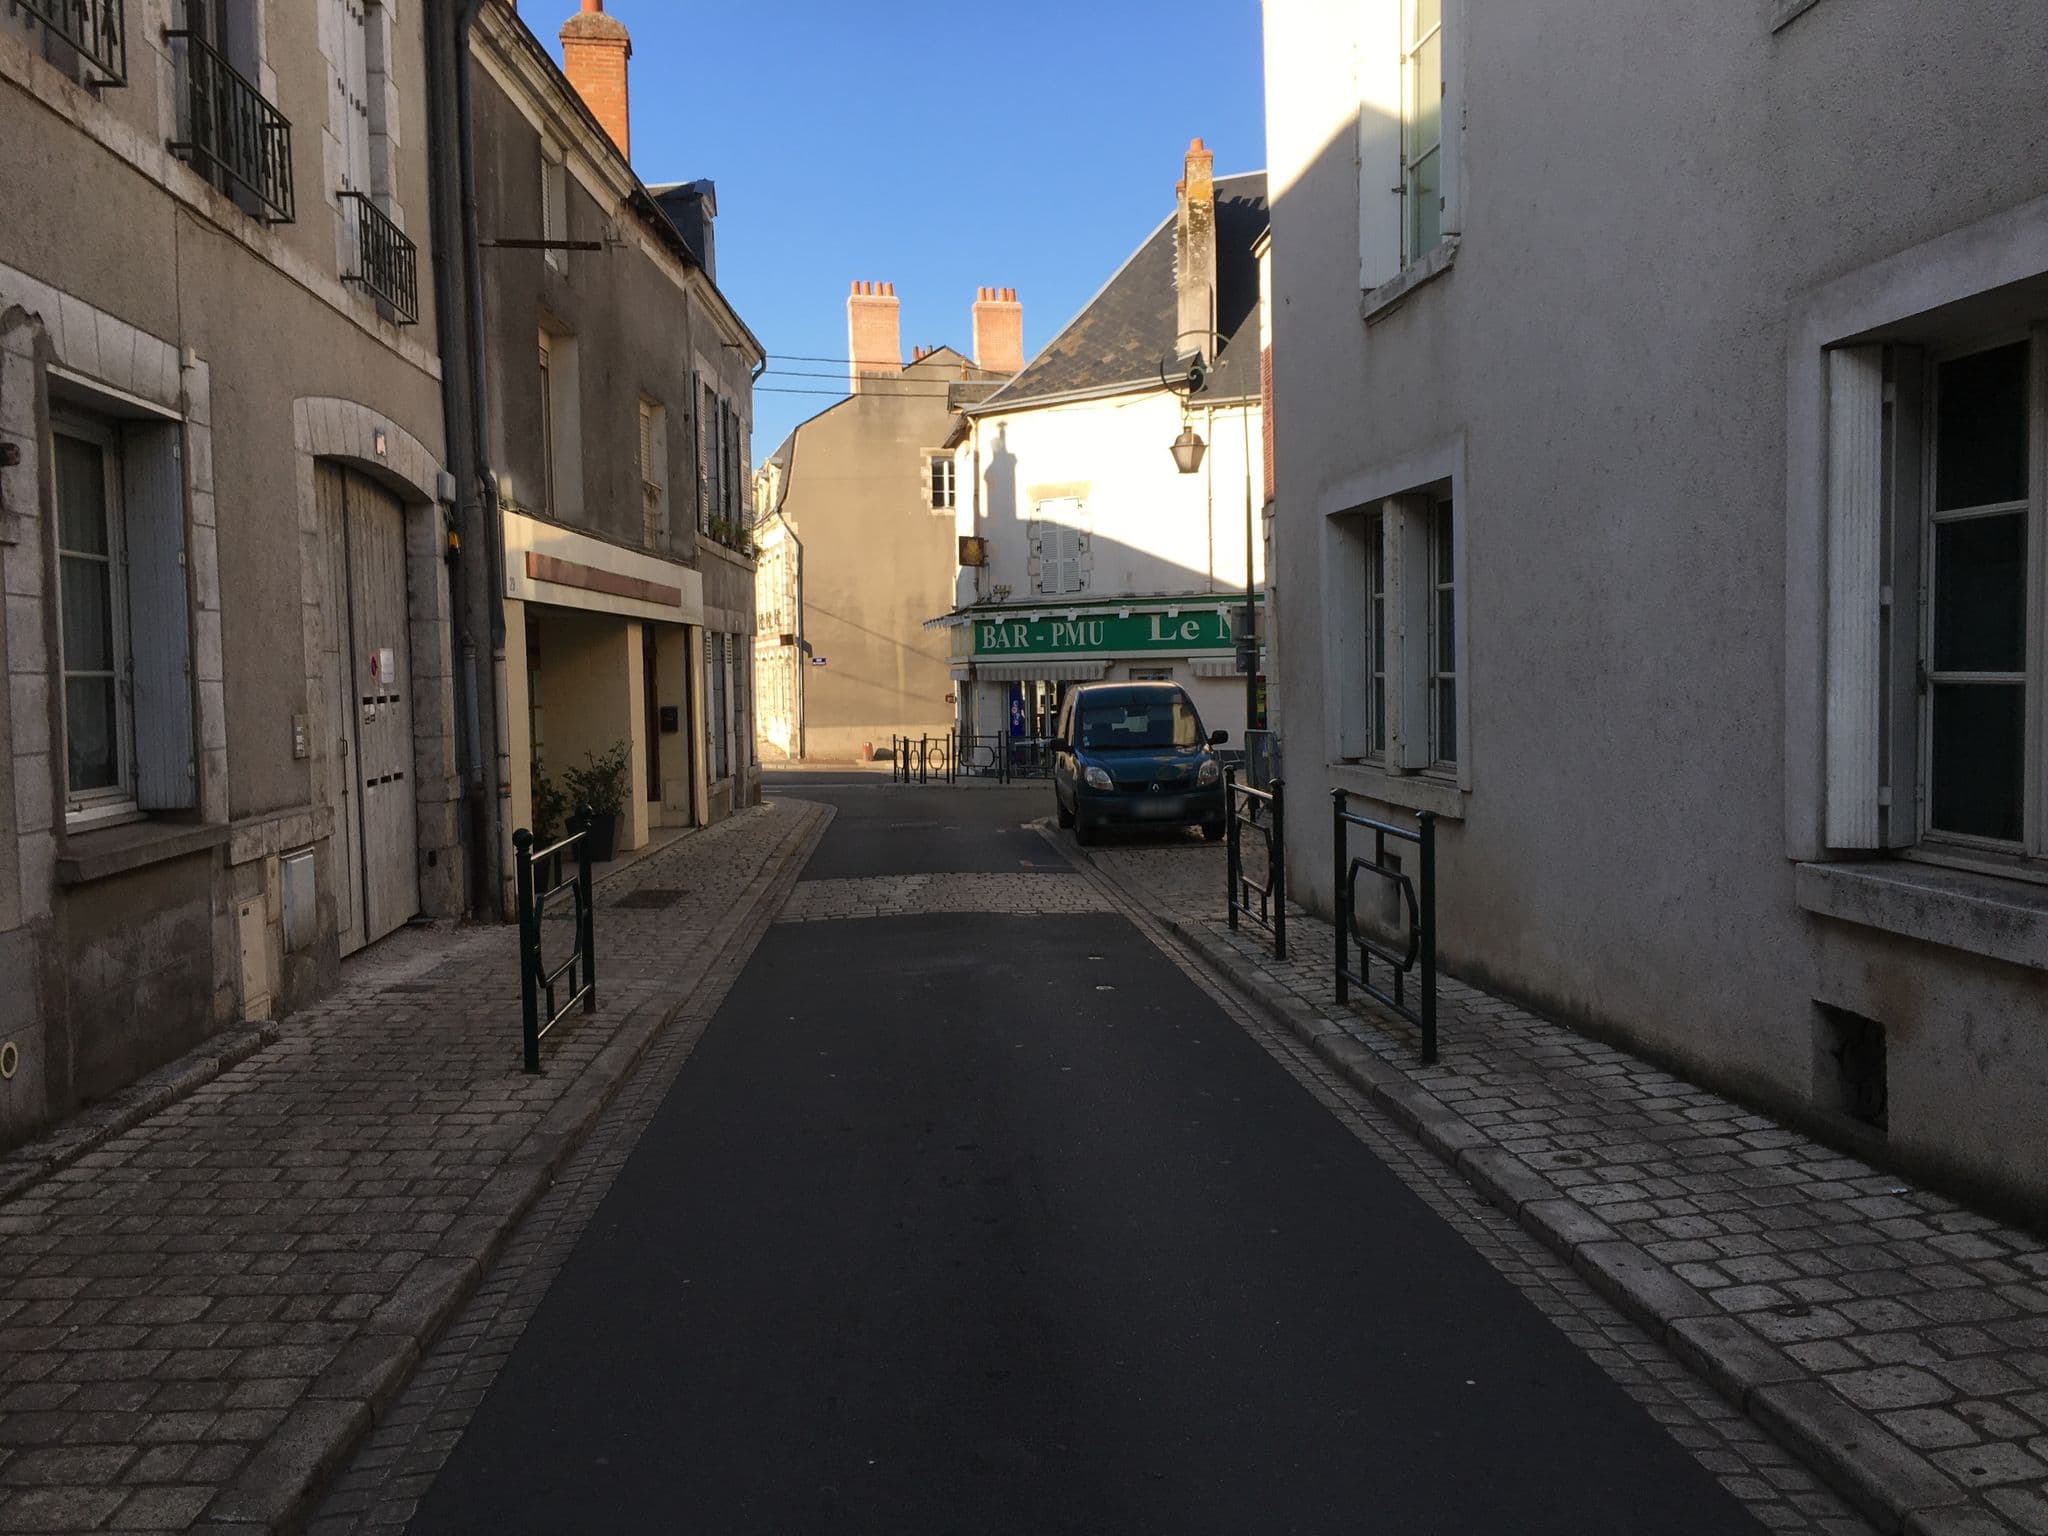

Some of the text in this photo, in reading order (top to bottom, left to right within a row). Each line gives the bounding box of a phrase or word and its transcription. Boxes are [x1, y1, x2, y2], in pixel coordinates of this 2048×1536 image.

[982, 623, 1030, 649] BAR
[1051, 620, 1105, 647] PMU
[1147, 614, 1200, 641] Le
